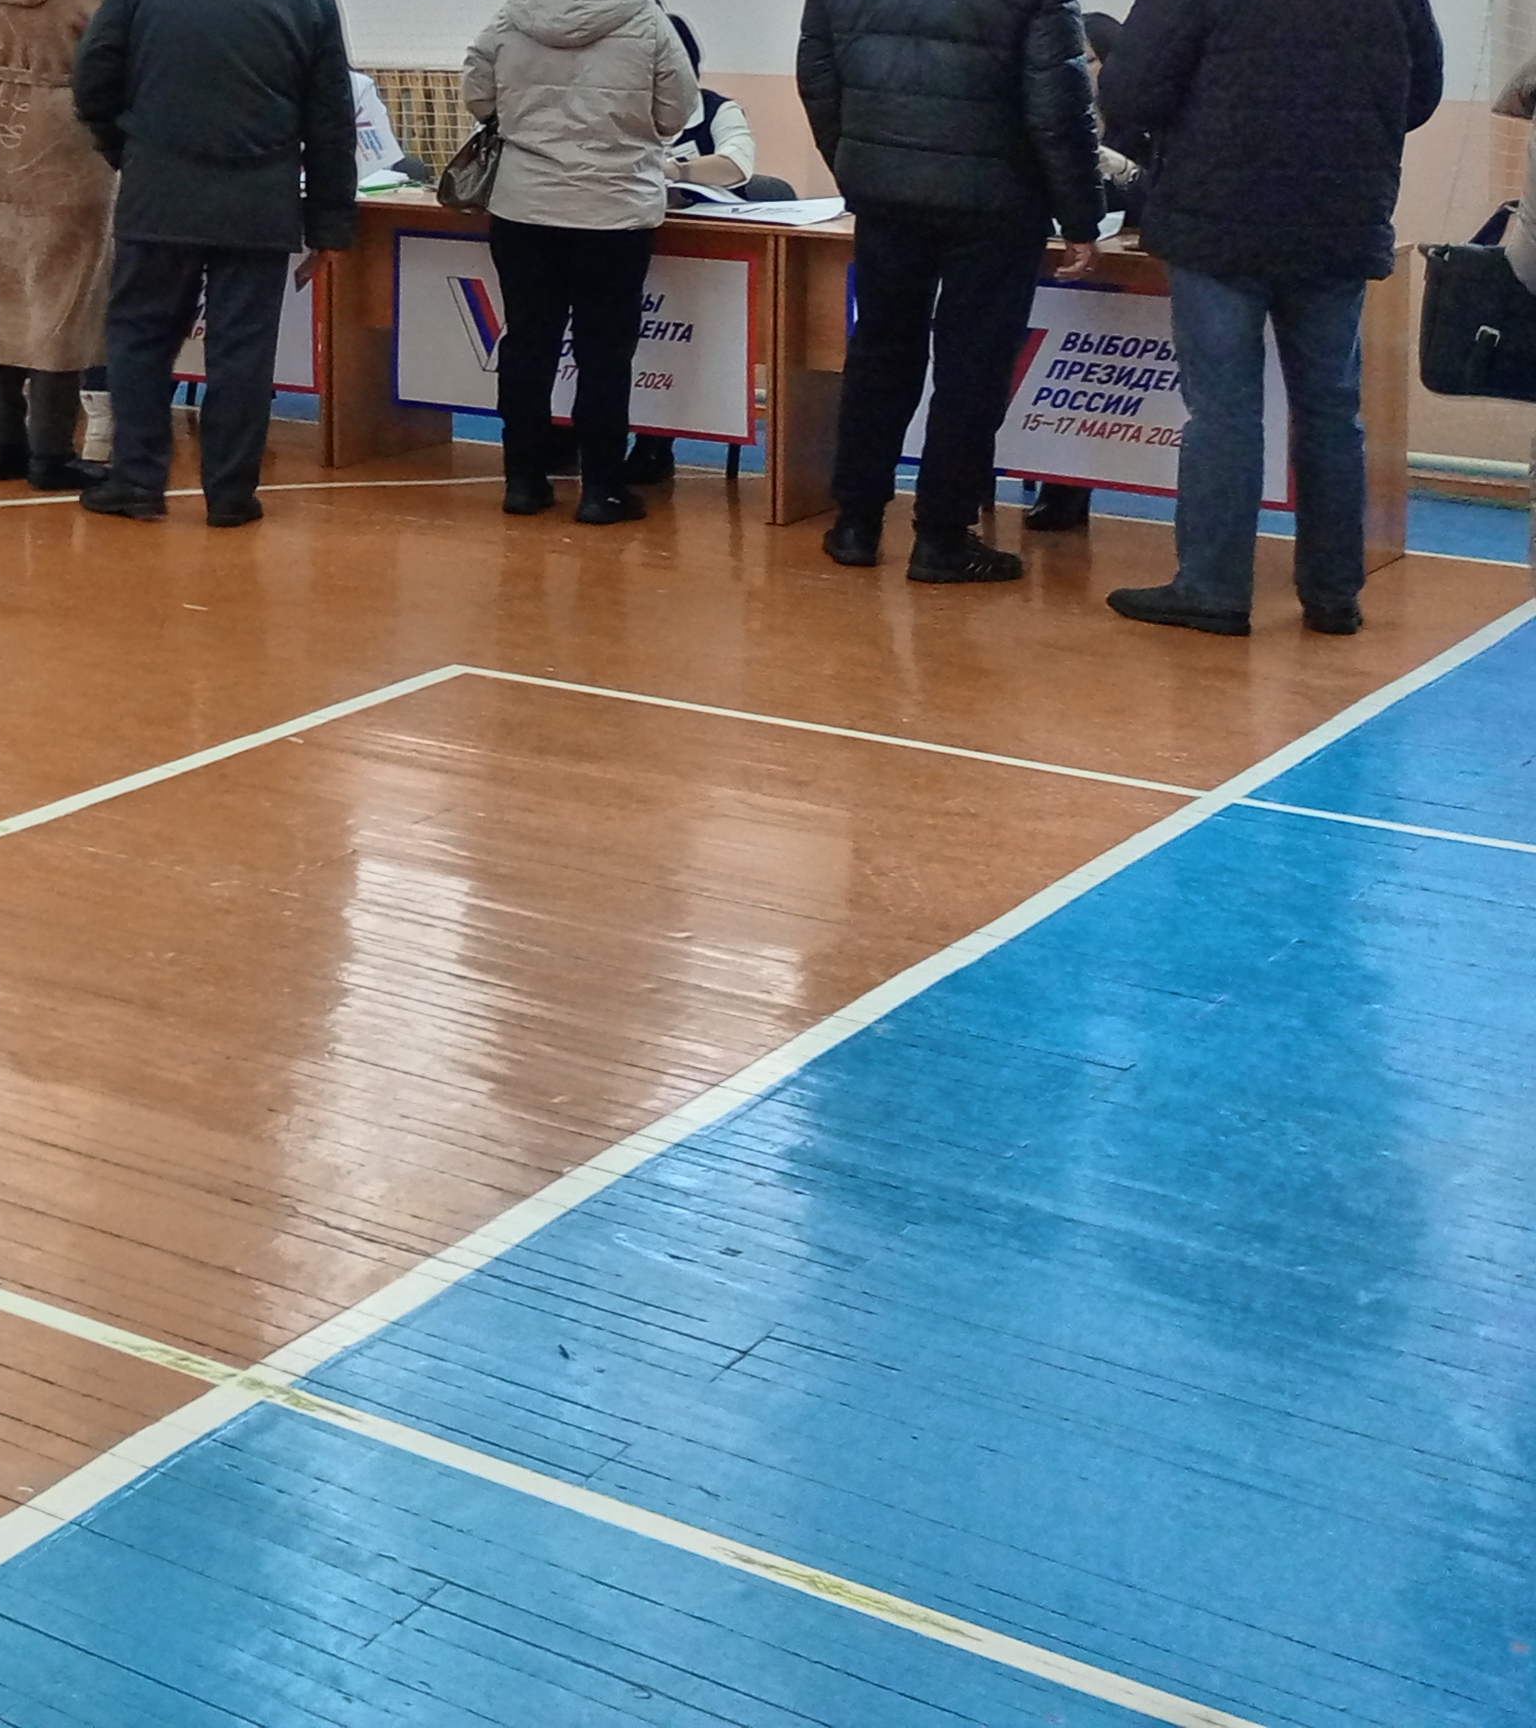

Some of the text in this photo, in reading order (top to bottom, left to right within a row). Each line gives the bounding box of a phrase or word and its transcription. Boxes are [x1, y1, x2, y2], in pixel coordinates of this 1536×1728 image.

[1059, 331, 1177, 362] ВЫБОРЫ
[633, 371, 674, 390] 2024
[1045, 358, 1181, 392] ПРЕЗИДЕ
[1031, 386, 1145, 417] РОССИИ
[1075, 419, 1144, 444] МАРТА
[1145, 426, 1185, 448] 202
